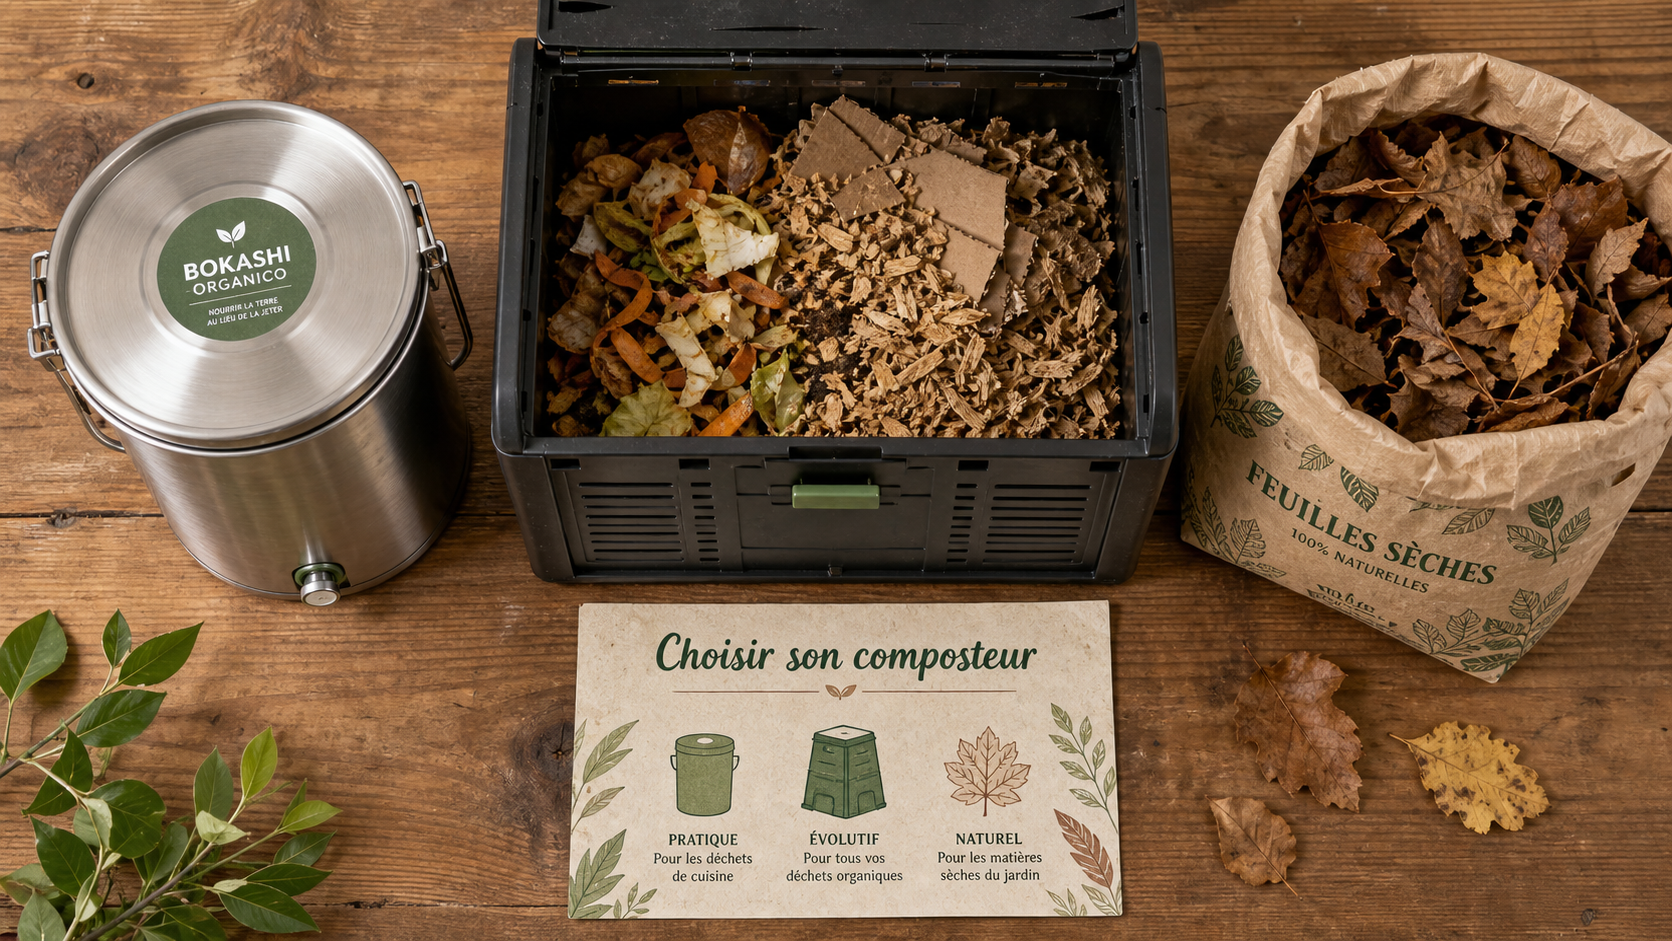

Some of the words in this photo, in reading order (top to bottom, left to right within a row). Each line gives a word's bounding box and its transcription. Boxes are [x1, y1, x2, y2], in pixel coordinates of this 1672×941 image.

[184, 245, 291, 281] BOKASHI
[193, 268, 287, 295] ORGANICO
[208, 303, 242, 316] NOURRIR
[244, 302, 254, 310] LA
[255, 297, 279, 307] TERRE
[207, 317, 218, 327] AU
[238, 312, 248, 321] DE
[250, 310, 260, 319] LA
[261, 305, 283, 317] JETER
[1245, 459, 1378, 553] FEUILLES
[1384, 541, 1498, 585] SÈCHES
[1291, 528, 1329, 556] 100%
[1333, 551, 1430, 594] NATURELLES
[655, 632, 775, 671] Choisir
[786, 647, 843, 671] son
[853, 641, 1037, 681] composteur
[668, 833, 738, 848] PRATIQUE
[809, 830, 880, 846] ÉVOLUTIF
[955, 833, 1023, 845] NATUREL
[653, 852, 682, 864] Pour
[686, 852, 702, 864] les
[706, 852, 753, 864] déchets
[803, 852, 832, 864] Pour
[835, 853, 861, 864] tous
[865, 855, 885, 864] vos
[938, 852, 966, 864] Pour
[969, 851, 987, 863] les
[990, 851, 1042, 864] matières
[672, 870, 687, 882] de
[691, 870, 734, 882] cuisine
[786, 869, 833, 882] déchets
[836, 870, 903, 885] organiques
[940, 869, 980, 882] sèches
[984, 869, 1000, 881] du
[1003, 869, 1040, 884] jardin
